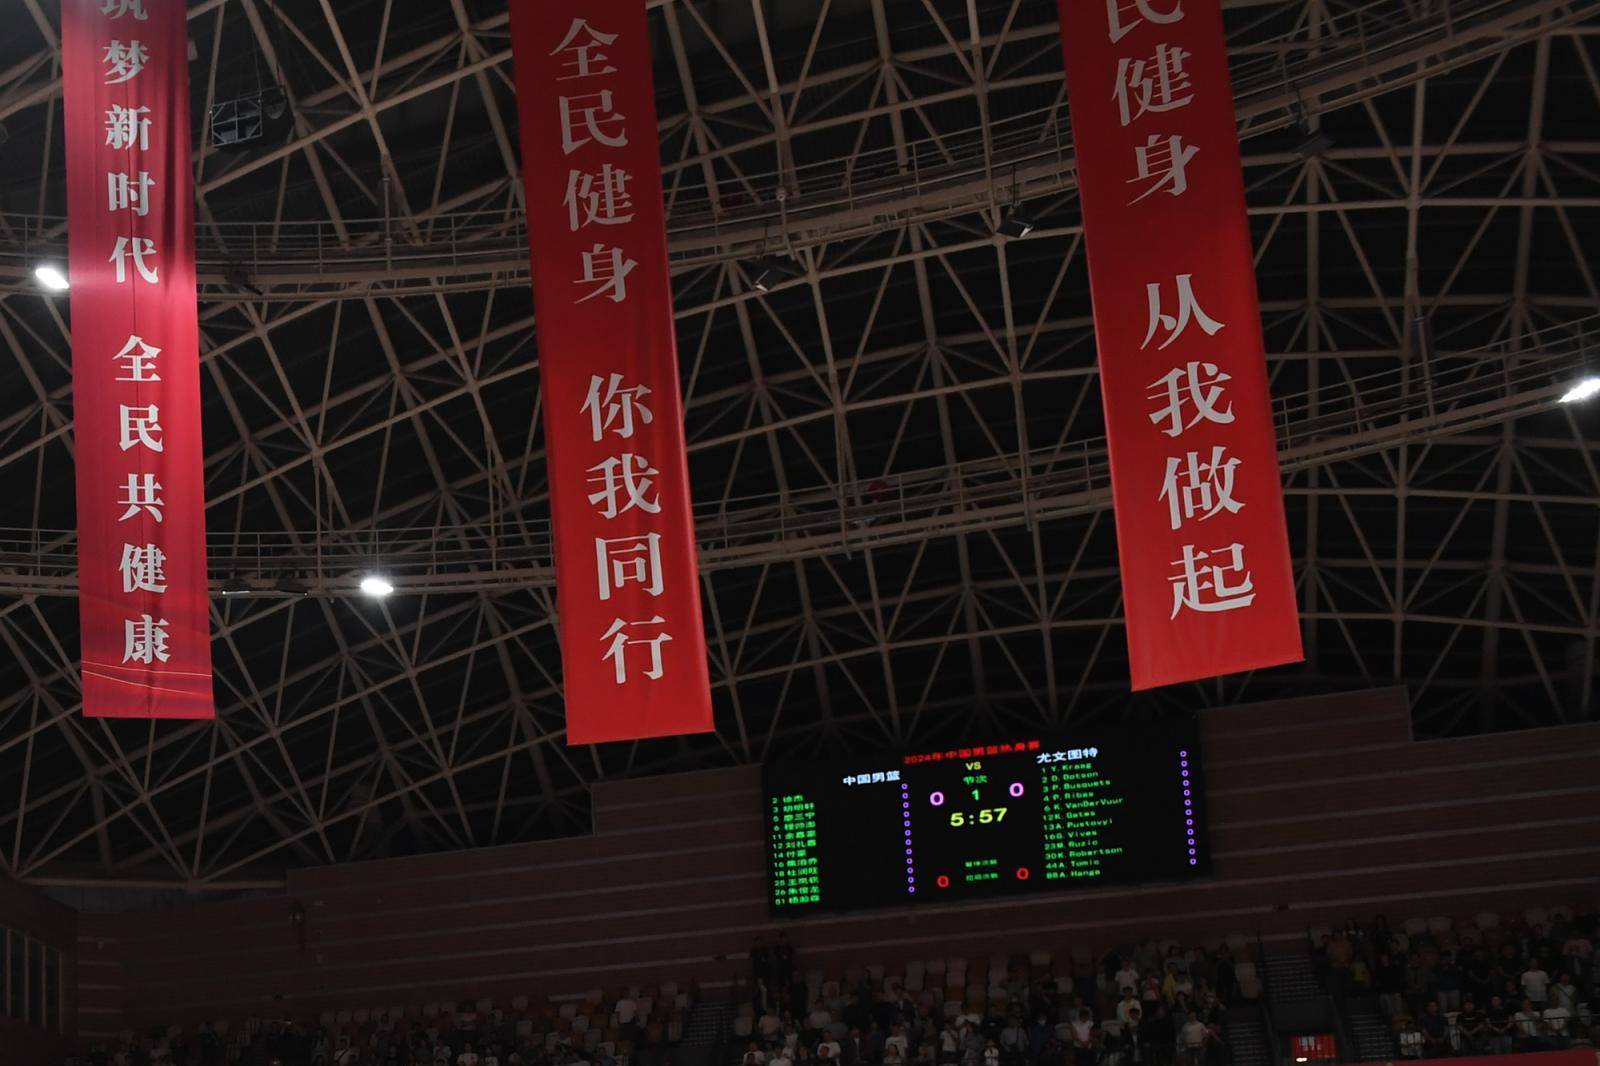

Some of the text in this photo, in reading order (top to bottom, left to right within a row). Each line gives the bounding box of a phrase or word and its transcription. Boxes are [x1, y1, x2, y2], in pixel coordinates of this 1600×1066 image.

[549, 18, 673, 684] 全民健身 你我同行
[1140, 273, 1256, 621] 从我做起
[112, 334, 172, 664] 全民共健康
[1037, 746, 1098, 764] 尤文图特
[965, 761, 982, 771] VS
[842, 769, 901, 787] 中国男篮
[1063, 771, 1098, 780] Dotson
[971, 789, 980, 801] 1
[1009, 782, 1024, 797] 0
[929, 791, 944, 806] 0
[950, 807, 1007, 827] 5:57
[1069, 847, 1123, 857] Robertson
[1016, 867, 1029, 880] 0
[936, 875, 949, 888] 0
